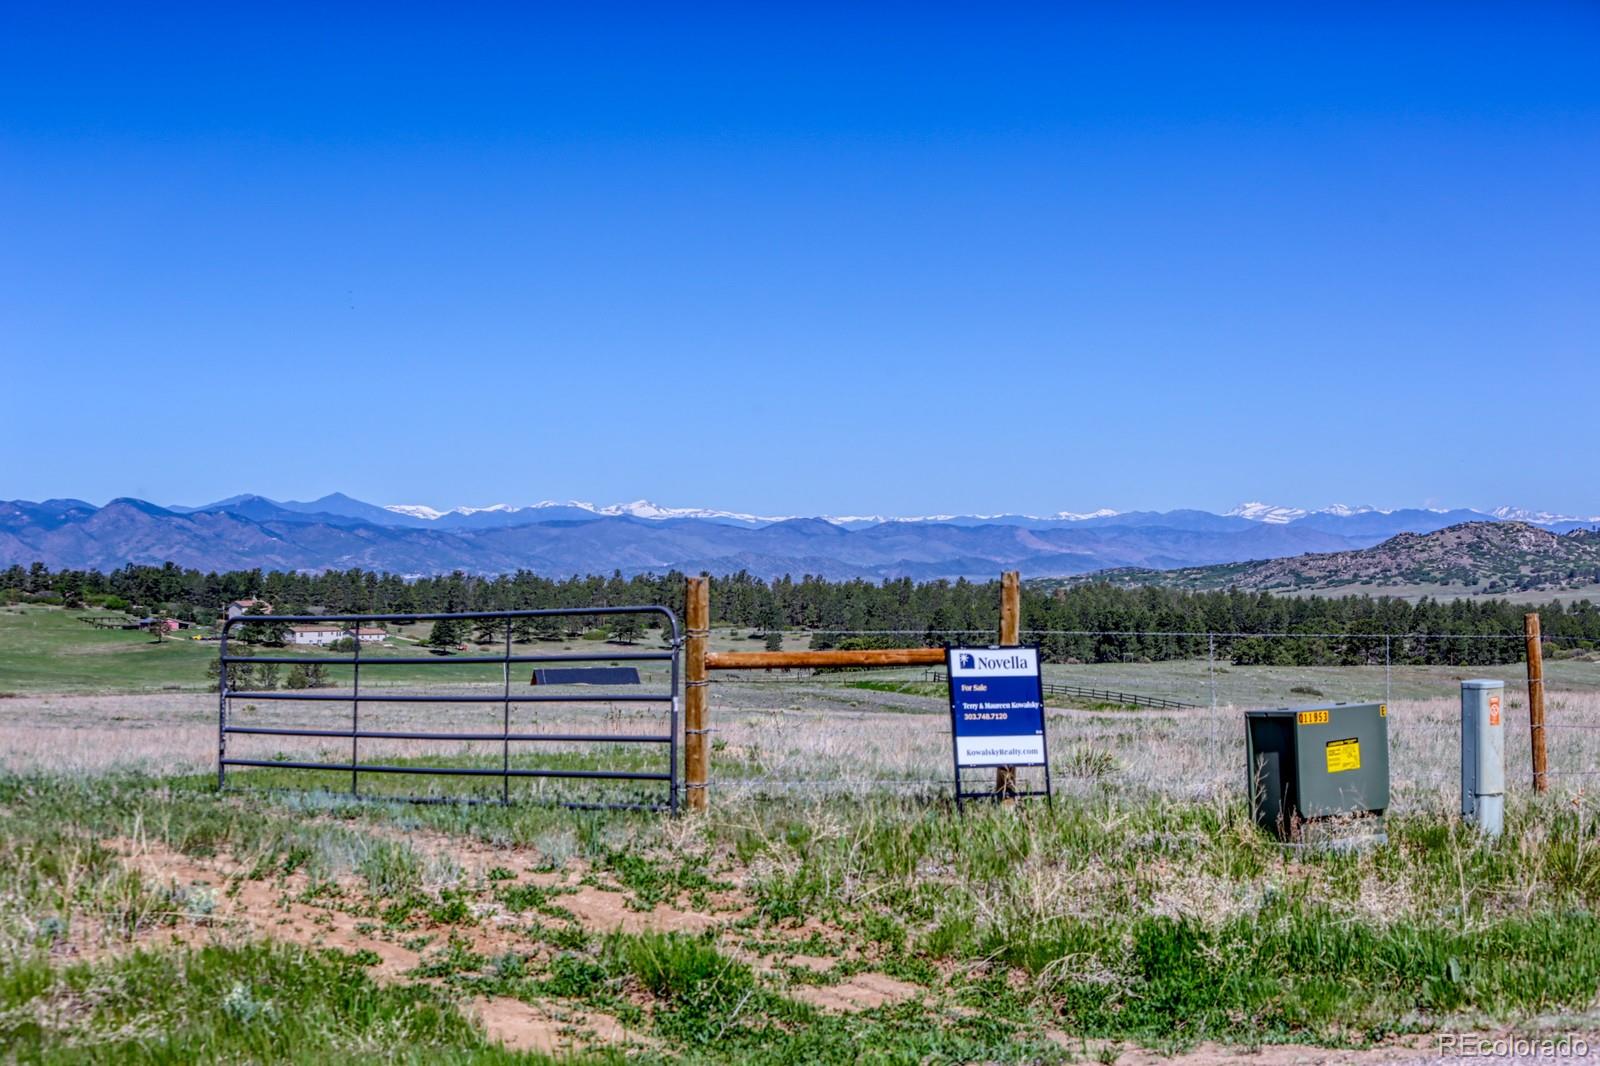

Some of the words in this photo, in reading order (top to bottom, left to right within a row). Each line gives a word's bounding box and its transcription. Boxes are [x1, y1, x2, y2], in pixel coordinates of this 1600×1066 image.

[978, 656, 1028, 670] Novella
[961, 684, 972, 692] For
[973, 684, 987, 692] Sale
[962, 702, 978, 711] Terry
[1011, 701, 1039, 710] Kowalsky
[966, 748, 1039, 757] KowalskyRealty.com
